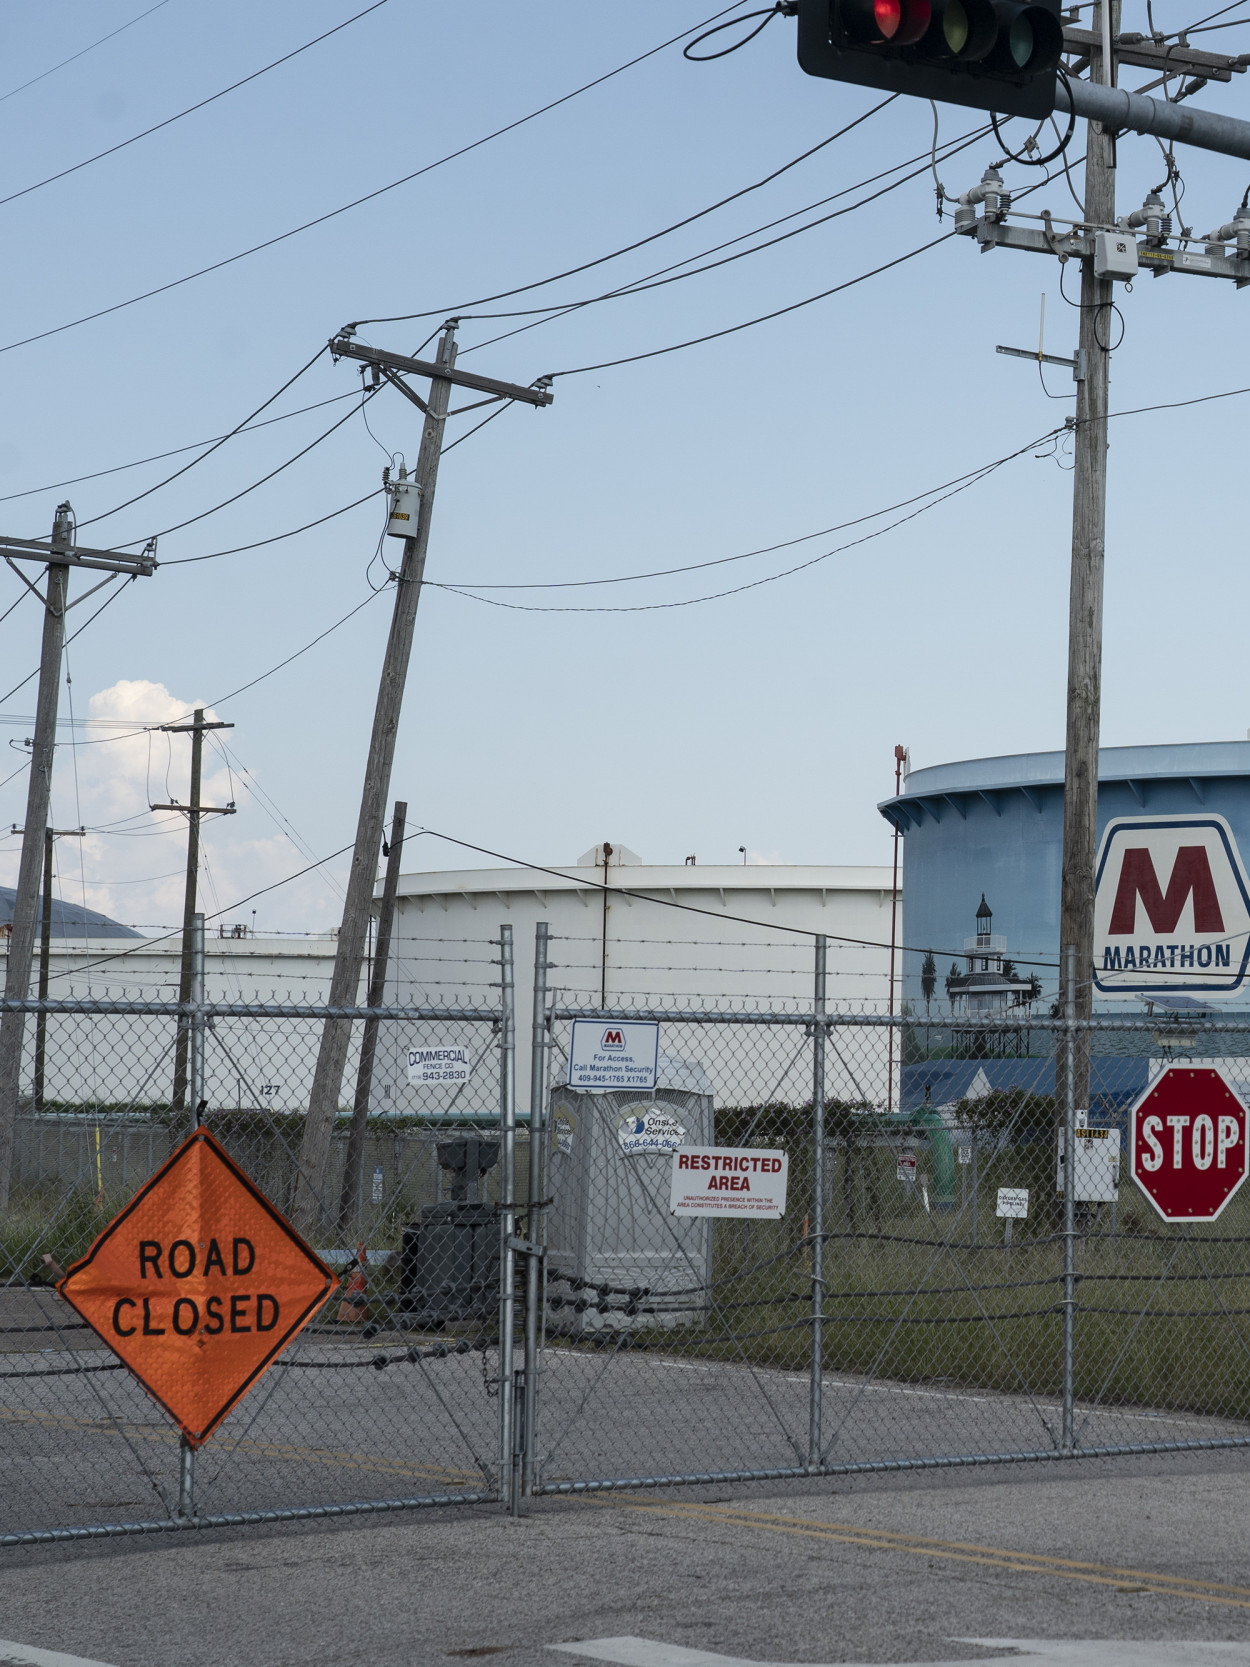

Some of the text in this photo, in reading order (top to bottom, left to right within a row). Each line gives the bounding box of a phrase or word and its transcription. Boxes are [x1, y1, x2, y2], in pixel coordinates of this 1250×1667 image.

[1108, 845, 1226, 935] M
[1103, 943, 1231, 969] MARATHON
[605, 1031, 622, 1043] M
[408, 1050, 468, 1066] COMMERCIAL
[607, 1055, 635, 1063] Access,
[423, 1071, 466, 1080] 943-2830
[625, 1066, 654, 1075] Security
[1142, 1114, 1239, 1172] STOP
[678, 1155, 782, 1173] RESTRICTED
[708, 1176, 750, 1191] AREA
[139, 1237, 256, 1279] ROAD
[112, 1294, 280, 1337] CLOSED
